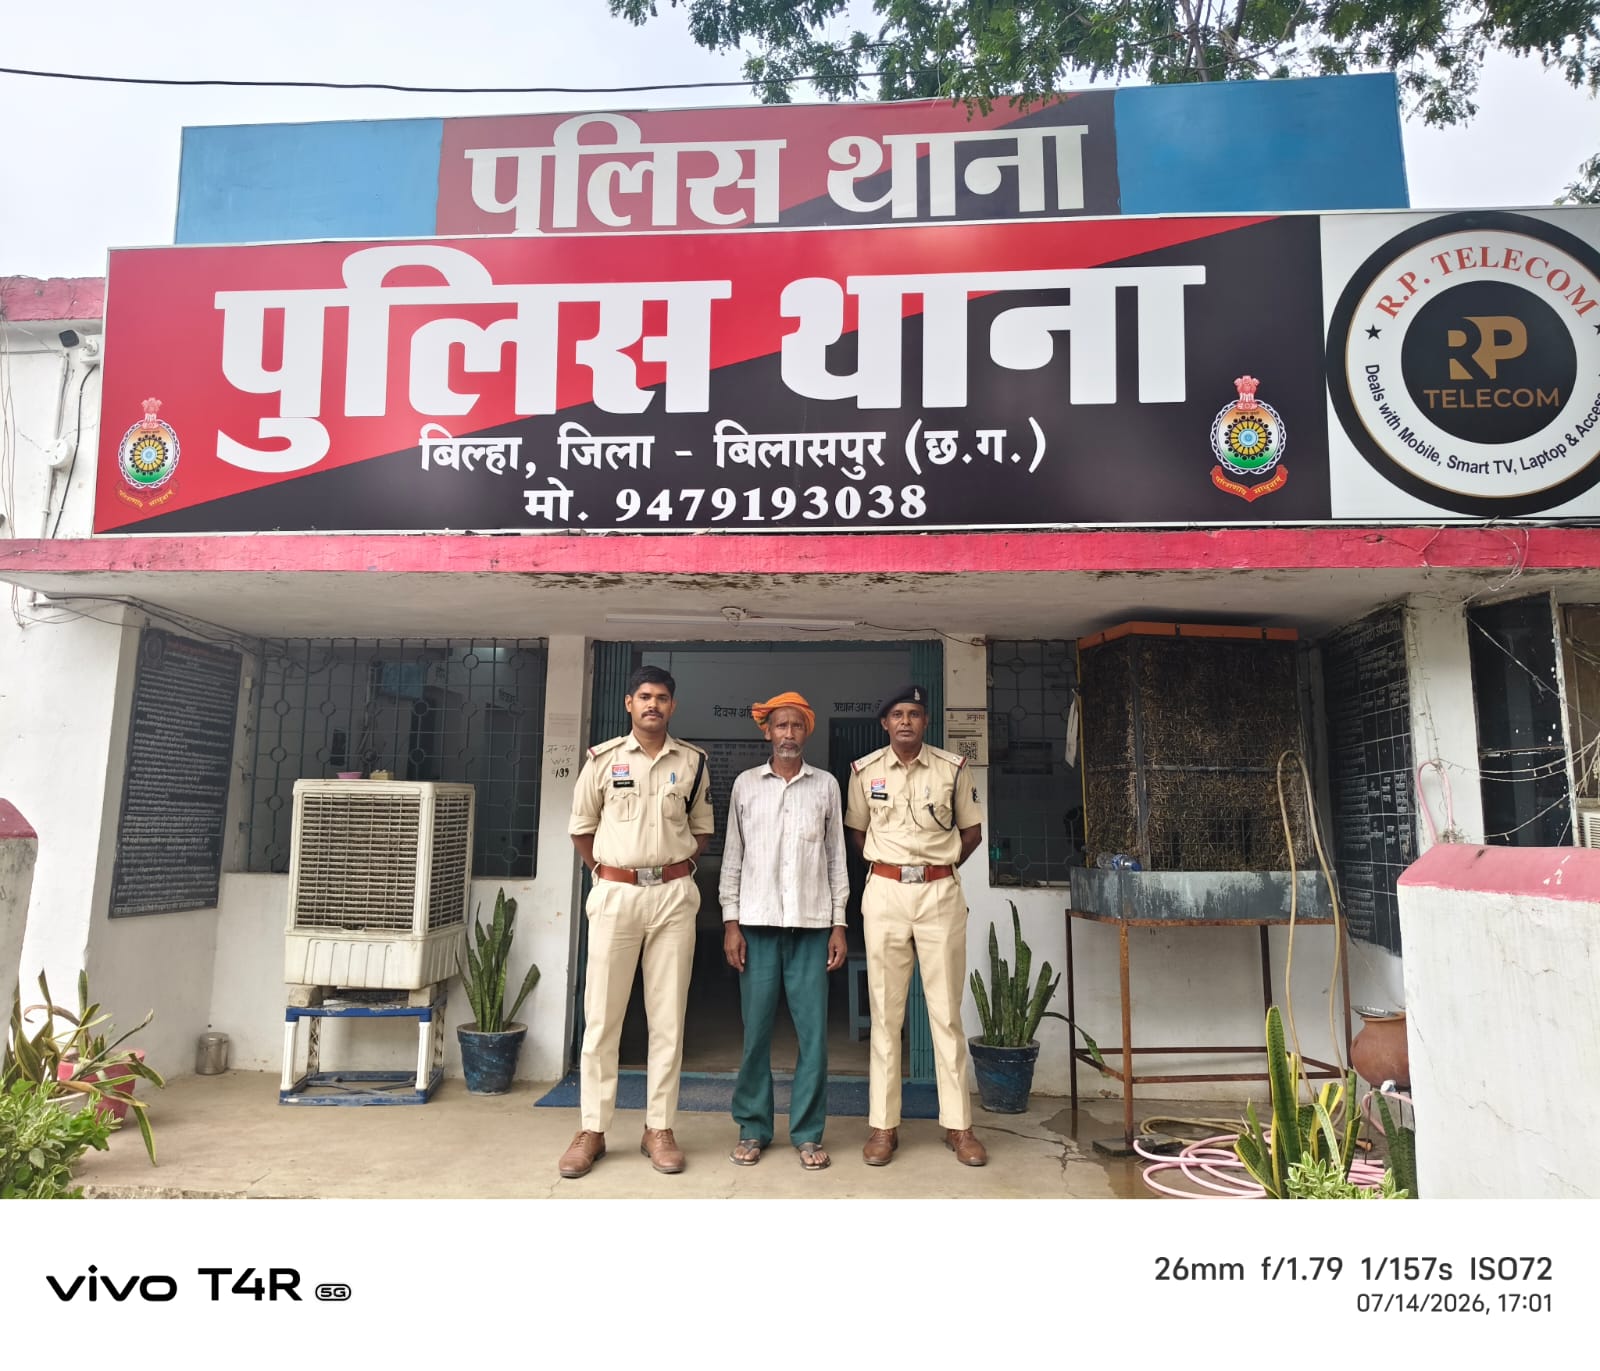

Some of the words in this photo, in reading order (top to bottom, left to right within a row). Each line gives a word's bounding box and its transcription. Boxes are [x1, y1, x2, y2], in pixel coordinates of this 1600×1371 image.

[464, 112, 787, 234] पलिस
[827, 124, 1089, 219] थाना
[1376, 271, 1430, 320] R.P.
[1431, 246, 1599, 318] TELECOM
[214, 245, 732, 473] पुलिस
[780, 264, 1207, 409] थाना
[1447, 316, 1528, 380] RP
[1365, 364, 1385, 402] Deals
[1379, 403, 1400, 438] with
[1397, 427, 1442, 466] Mobile,
[1447, 455, 1490, 475] Smart
[1493, 458, 1518, 476] TV,
[1520, 443, 1568, 471] Laptop
[1565, 433, 1579, 447] &
[1424, 387, 1560, 409] TELECOM
[419, 423, 537, 479] बिल्हा,
[557, 421, 655, 470] जिला
[713, 419, 886, 480] बिलासपुर
[905, 416, 1046, 475] (छ.ग.)
[524, 477, 589, 521] मो.
[616, 485, 927, 522] 9479193038
